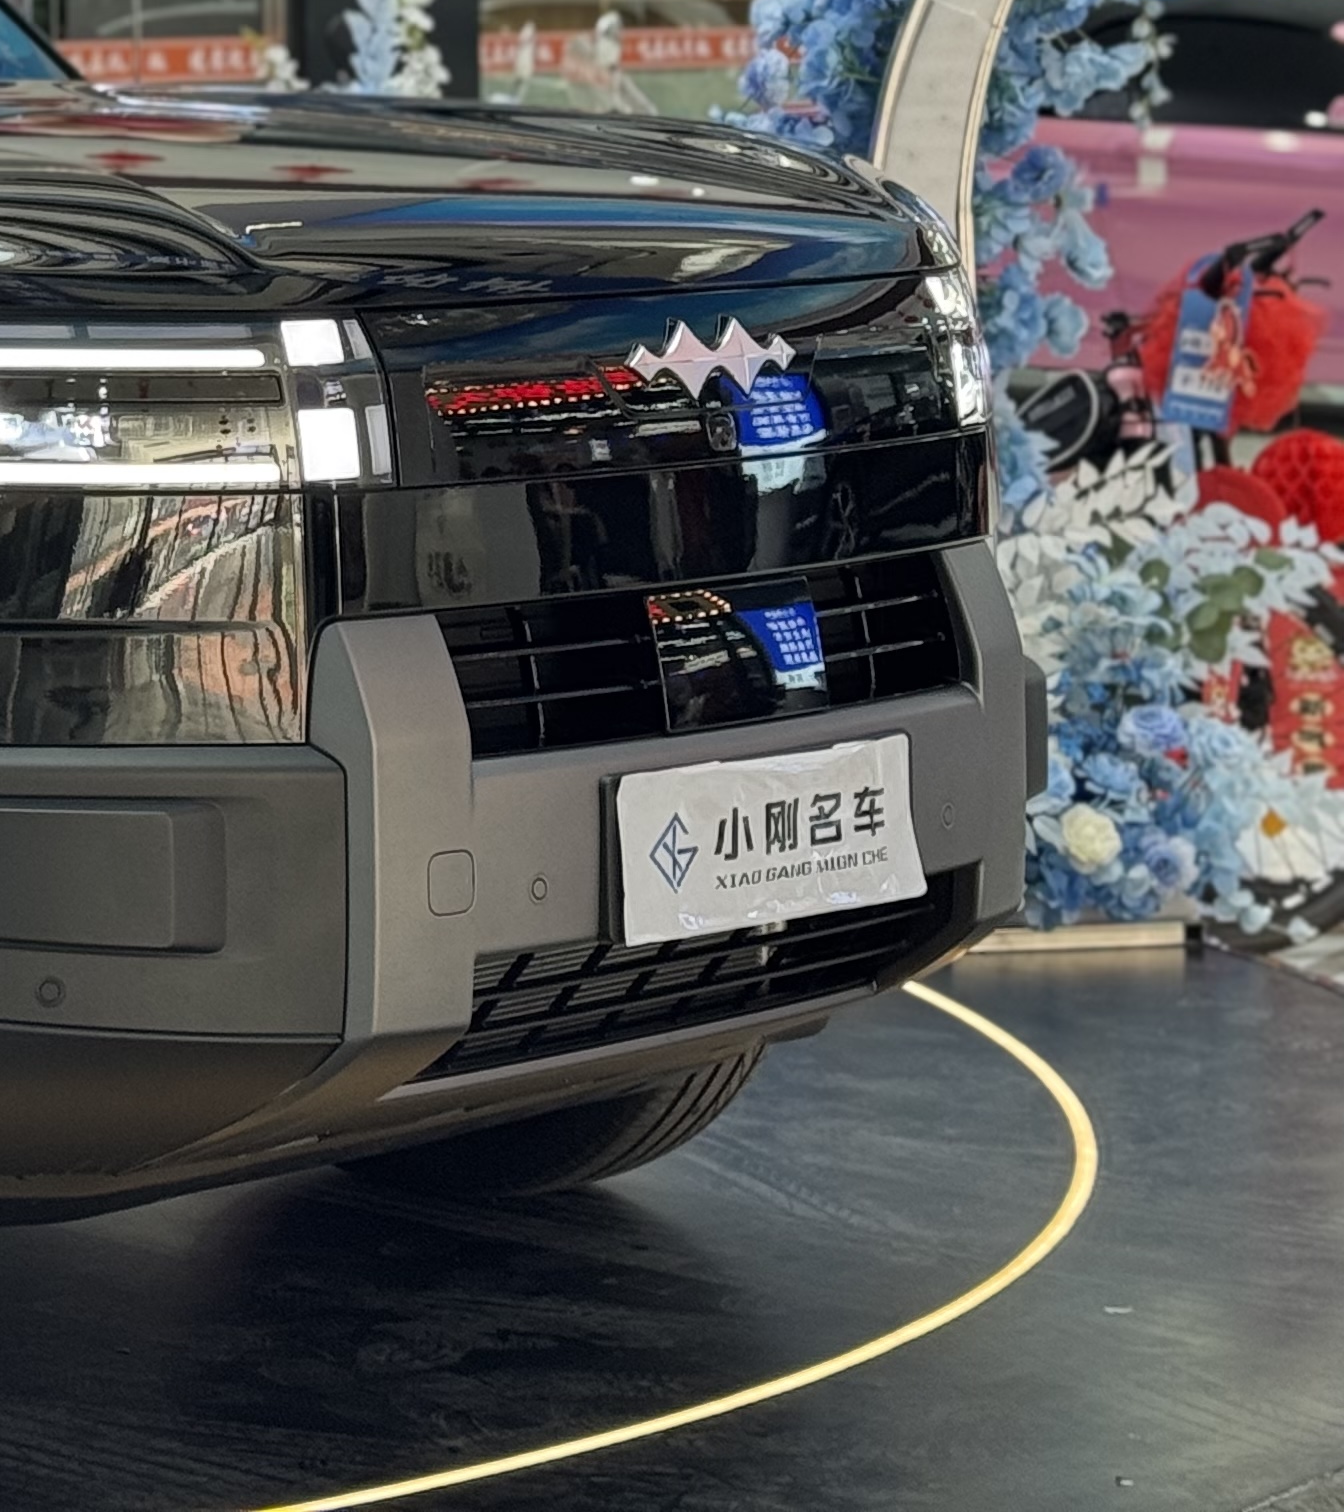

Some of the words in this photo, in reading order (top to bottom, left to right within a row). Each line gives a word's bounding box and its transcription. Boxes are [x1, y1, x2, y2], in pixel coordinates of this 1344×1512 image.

[714, 785, 885, 861] 小刚名车
[715, 870, 762, 890] XIAO
[765, 862, 813, 882] GANG
[862, 846, 888, 866] CHE
